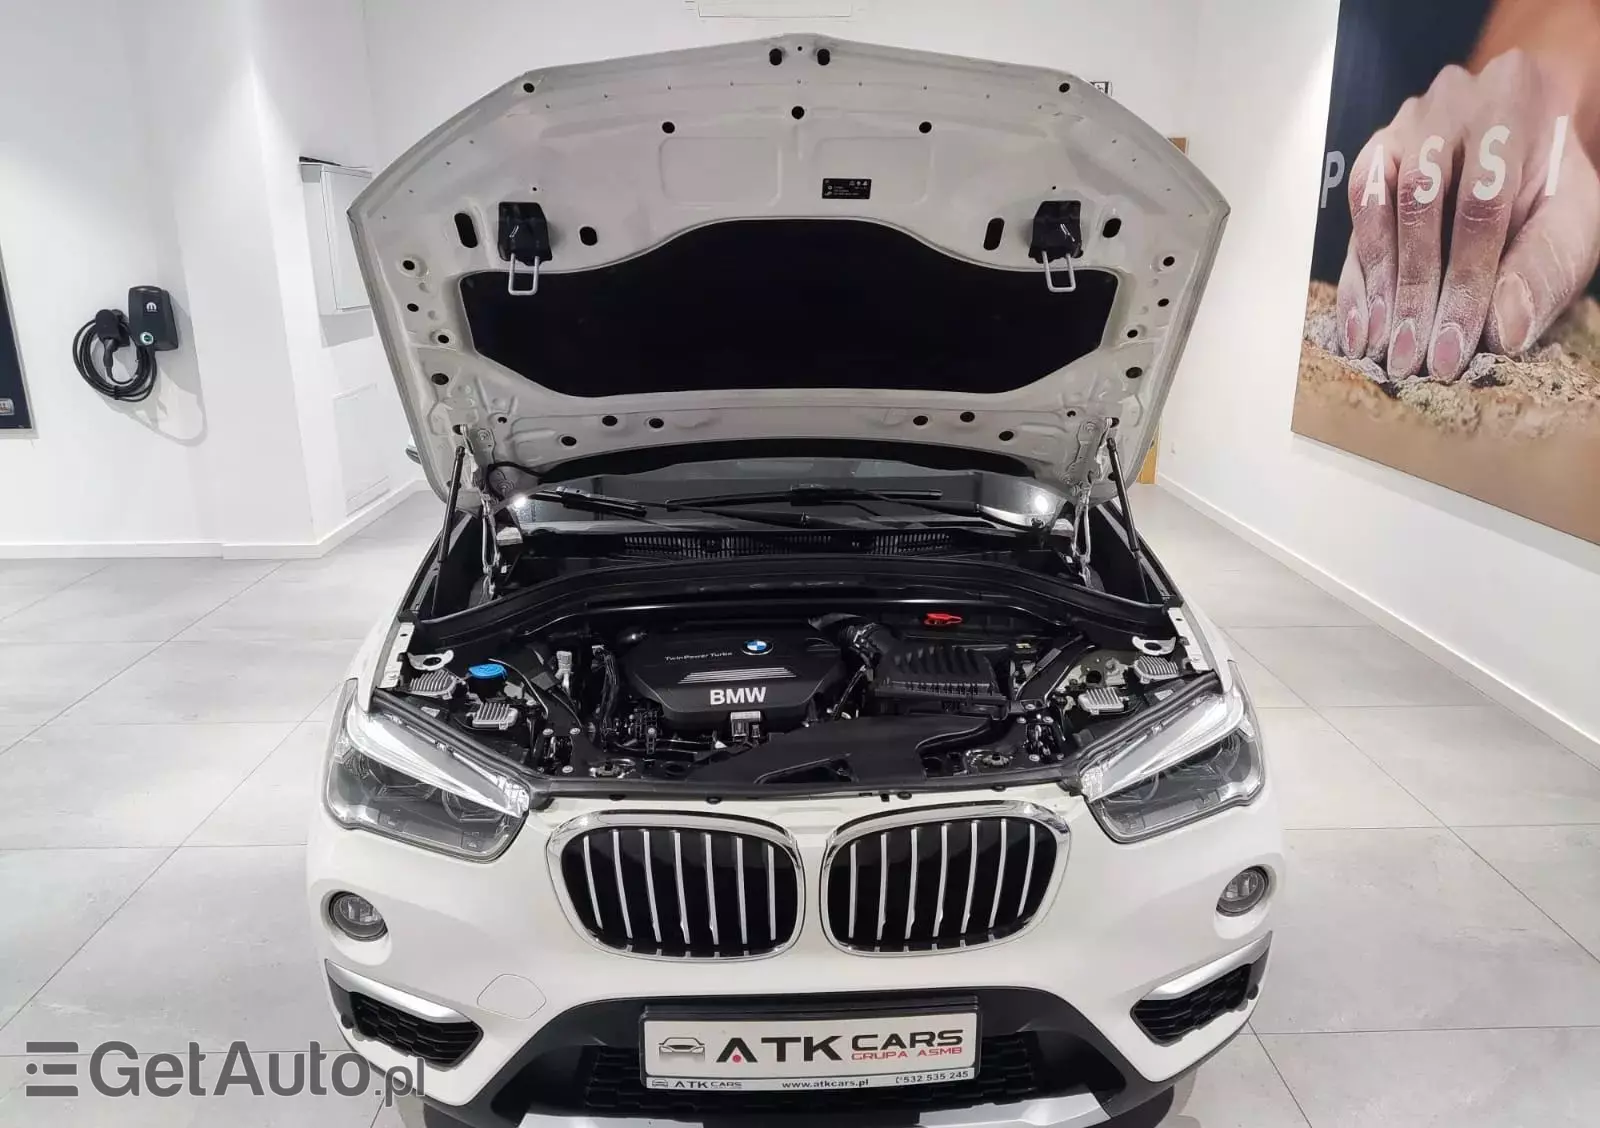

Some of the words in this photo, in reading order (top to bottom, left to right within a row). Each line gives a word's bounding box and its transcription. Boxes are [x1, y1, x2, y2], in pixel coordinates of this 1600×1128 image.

[1321, 114, 1569, 209] PASSI
[710, 686, 766, 705] BMW
[716, 1035, 843, 1063] ATK
[851, 1029, 964, 1052] CARS
[851, 1050, 909, 1061] GRUPA
[916, 1046, 963, 1058] ASMB
[673, 1080, 709, 1089] ATK
[781, 1078, 869, 1091] www.atkcars.pl
[904, 1074, 925, 1083] 532
[926, 1072, 948, 1082] 535
[949, 1070, 969, 1080] 245
